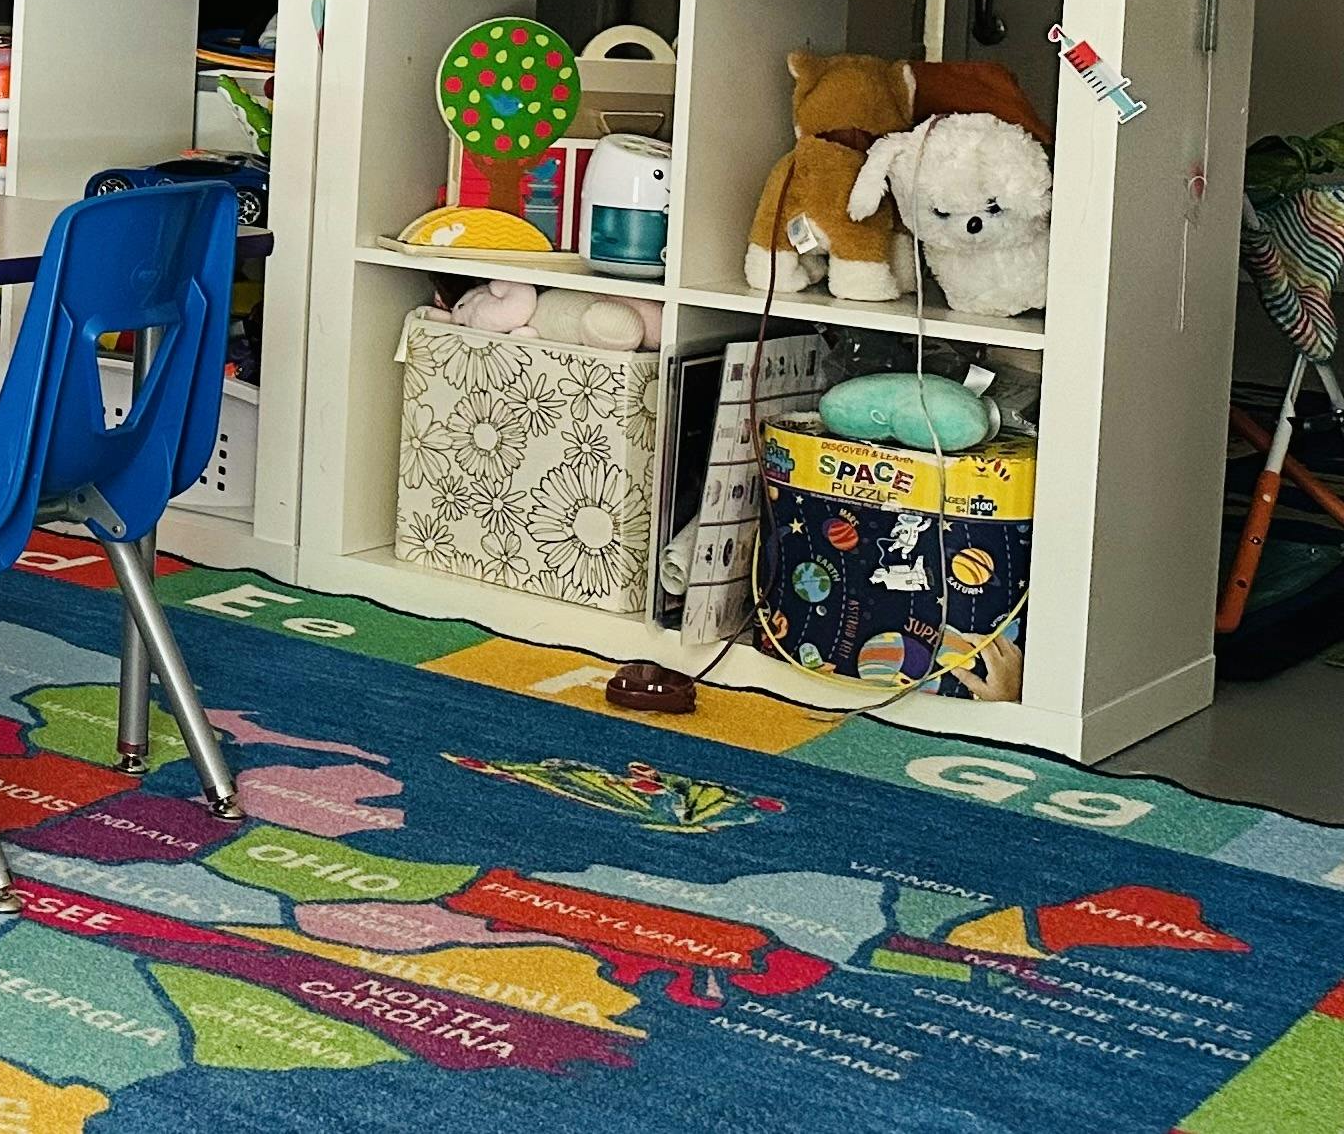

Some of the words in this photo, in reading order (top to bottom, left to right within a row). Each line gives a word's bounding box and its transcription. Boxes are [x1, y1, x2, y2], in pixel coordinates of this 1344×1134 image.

[821, 441, 869, 457] DISCOVER
[819, 454, 914, 494] SPACE
[839, 507, 860, 527] MARS
[973, 500, 993, 512] 100
[816, 554, 842, 583] EARTH
[946, 576, 984, 596] SATURN
[184, 583, 357, 639] Ee
[242, 779, 405, 830] MICHIGAN
[904, 754, 1155, 827] Gg
[85, 811, 201, 852] INDIANA
[245, 844, 403, 892] OHIO
[850, 861, 994, 903] VERMONT
[480, 882, 745, 965] PENNSYLVANIA
[1074, 900, 1217, 947] MAINE
[354, 979, 512, 1034] NORTH
[358, 951, 604, 1024] VIRGINIA
[815, 991, 896, 1020] NEW
[299, 980, 516, 1058] CAROLINA
[737, 1000, 922, 1063] DELAWARE
[1003, 986, 1117, 1027] RHODE
[1125, 1022, 1252, 1063] ISLAND
[709, 1015, 902, 1082] MARYLAND
